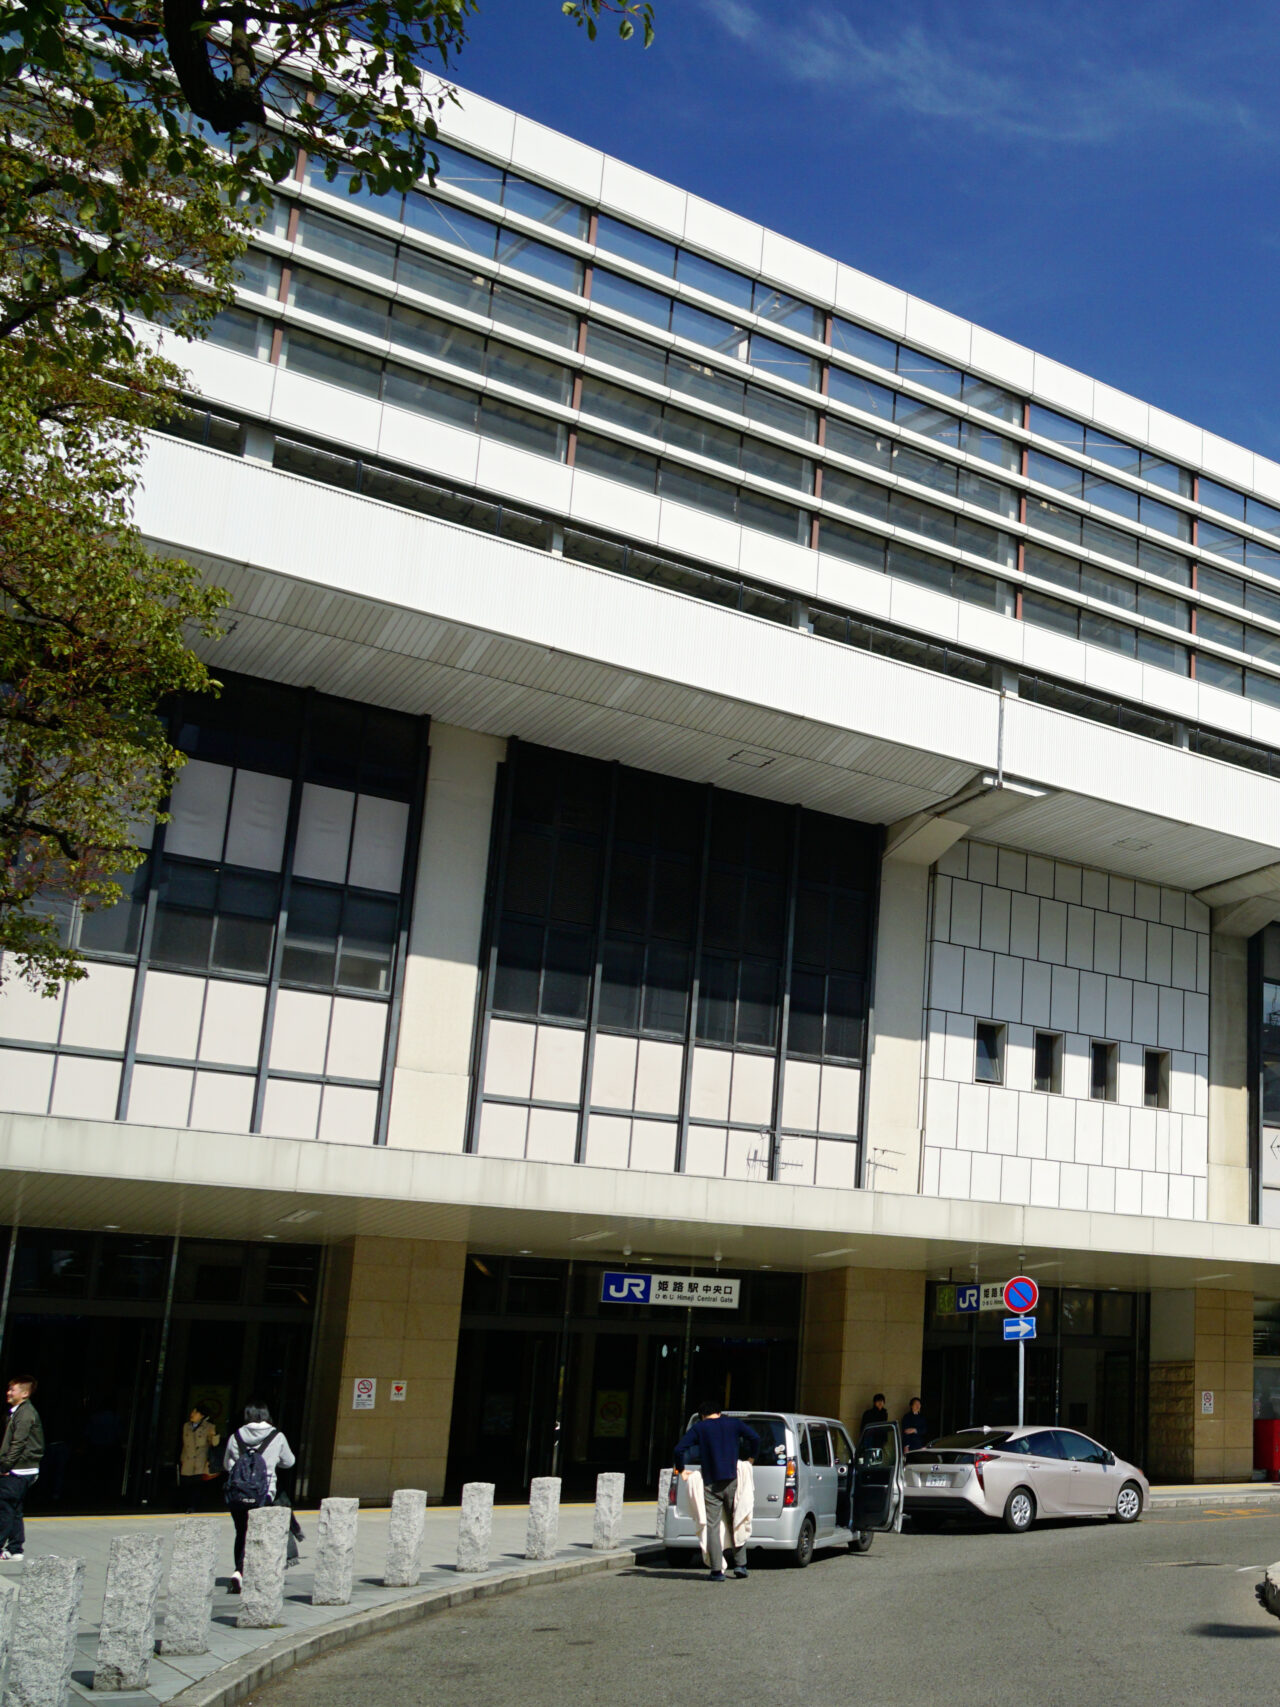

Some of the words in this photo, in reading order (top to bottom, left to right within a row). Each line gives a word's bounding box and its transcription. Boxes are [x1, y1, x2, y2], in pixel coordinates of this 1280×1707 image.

[609, 1278, 646, 1299] JR
[657, 1280, 699, 1293] 姫路駅
[702, 1285, 733, 1295] 中央口
[959, 1289, 978, 1309] JR
